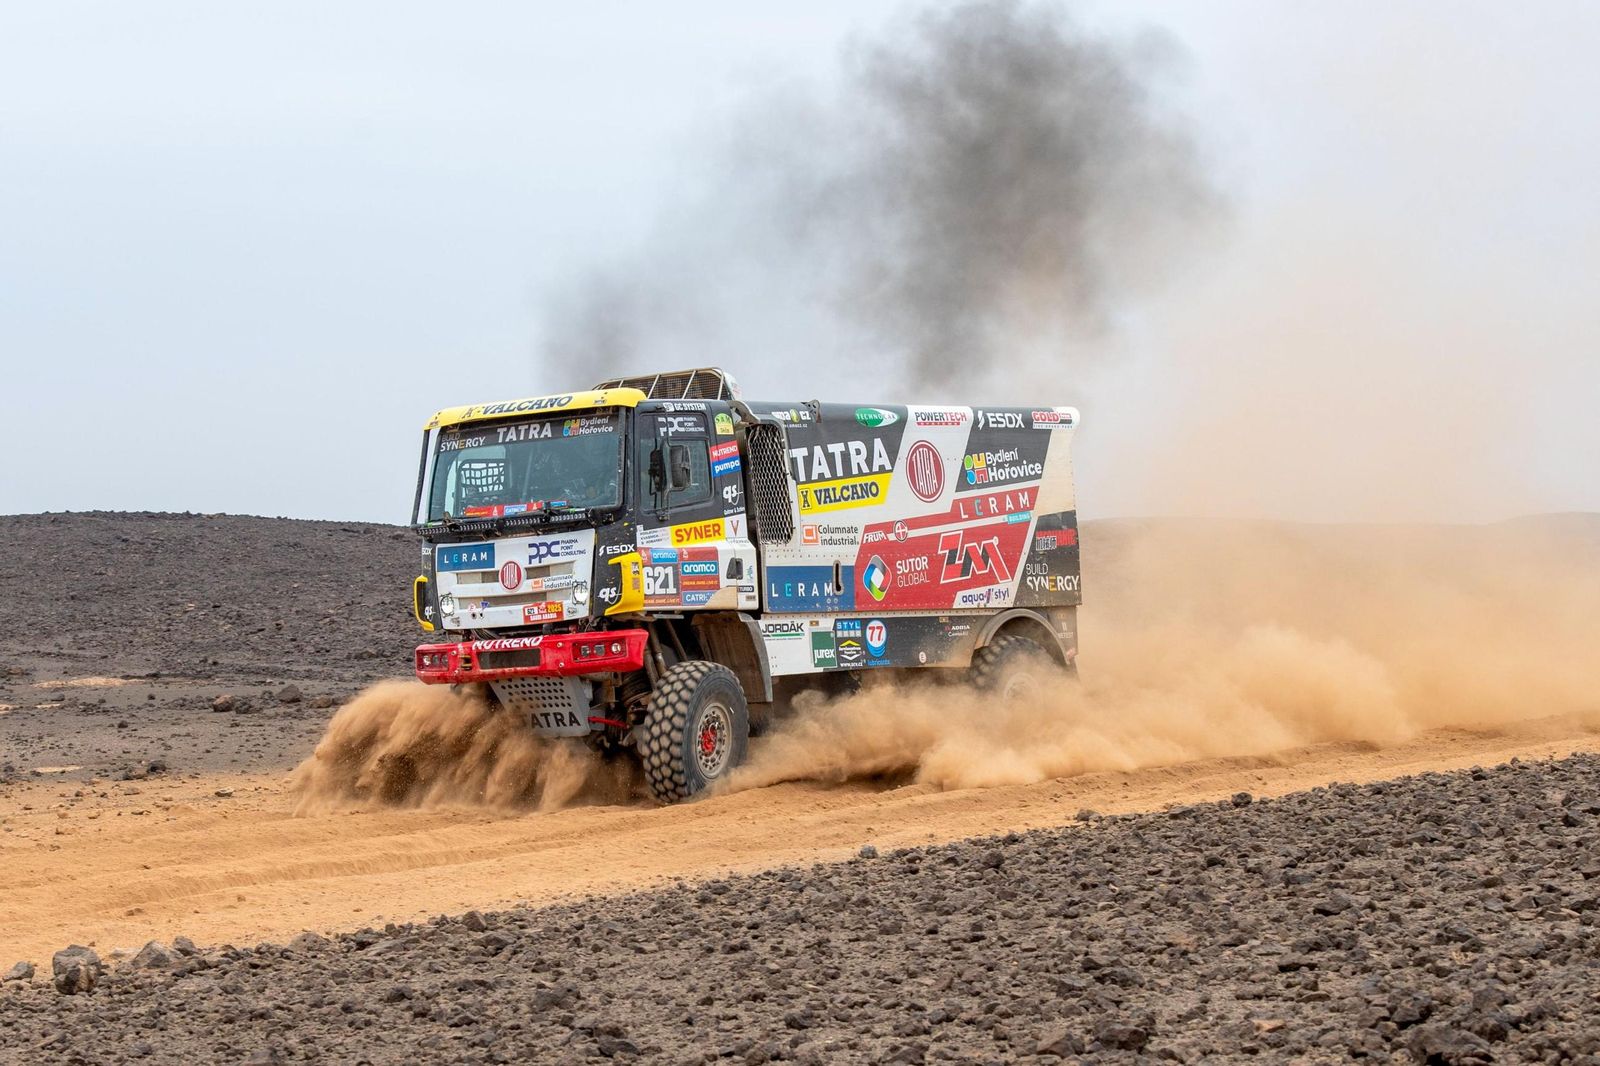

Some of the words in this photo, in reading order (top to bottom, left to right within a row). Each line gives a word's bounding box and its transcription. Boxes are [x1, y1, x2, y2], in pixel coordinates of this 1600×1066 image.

[483, 396, 573, 415] VALCANO
[684, 402, 706, 411] SYSTEM
[914, 411, 967, 421] POWERTECH
[987, 412, 1025, 428] ESOX
[1032, 411, 1060, 422] GOLD
[497, 422, 552, 443] TATRA
[579, 424, 614, 435] Hořovice
[441, 436, 486, 452] SYNERGY
[712, 445, 738, 458] NUTREND
[789, 438, 893, 482] TATRA
[985, 447, 1019, 466] Bydlení
[715, 459, 740, 473] pumpa
[911, 447, 939, 496] TATRA
[988, 460, 1042, 482] Hořovice
[814, 481, 880, 505] VALCANO
[960, 491, 1030, 519] LERAM
[675, 522, 721, 544] SYNER
[818, 525, 859, 535] Columnate
[422, 547, 433, 555] SOX
[606, 543, 635, 555] ESOX
[652, 551, 677, 559] aramco
[444, 551, 488, 564] LERAM
[896, 556, 929, 574] SUTOR
[684, 563, 716, 573] aramco
[1026, 563, 1049, 575] BUILD
[643, 566, 677, 595] 621
[897, 574, 930, 587] GLOBAL
[1027, 575, 1080, 592] SYNERGY
[771, 582, 833, 597] LERAM
[836, 622, 861, 630] STYL
[868, 626, 884, 642] 77
[472, 635, 544, 650] NUTREND
[813, 648, 836, 664] jurex
